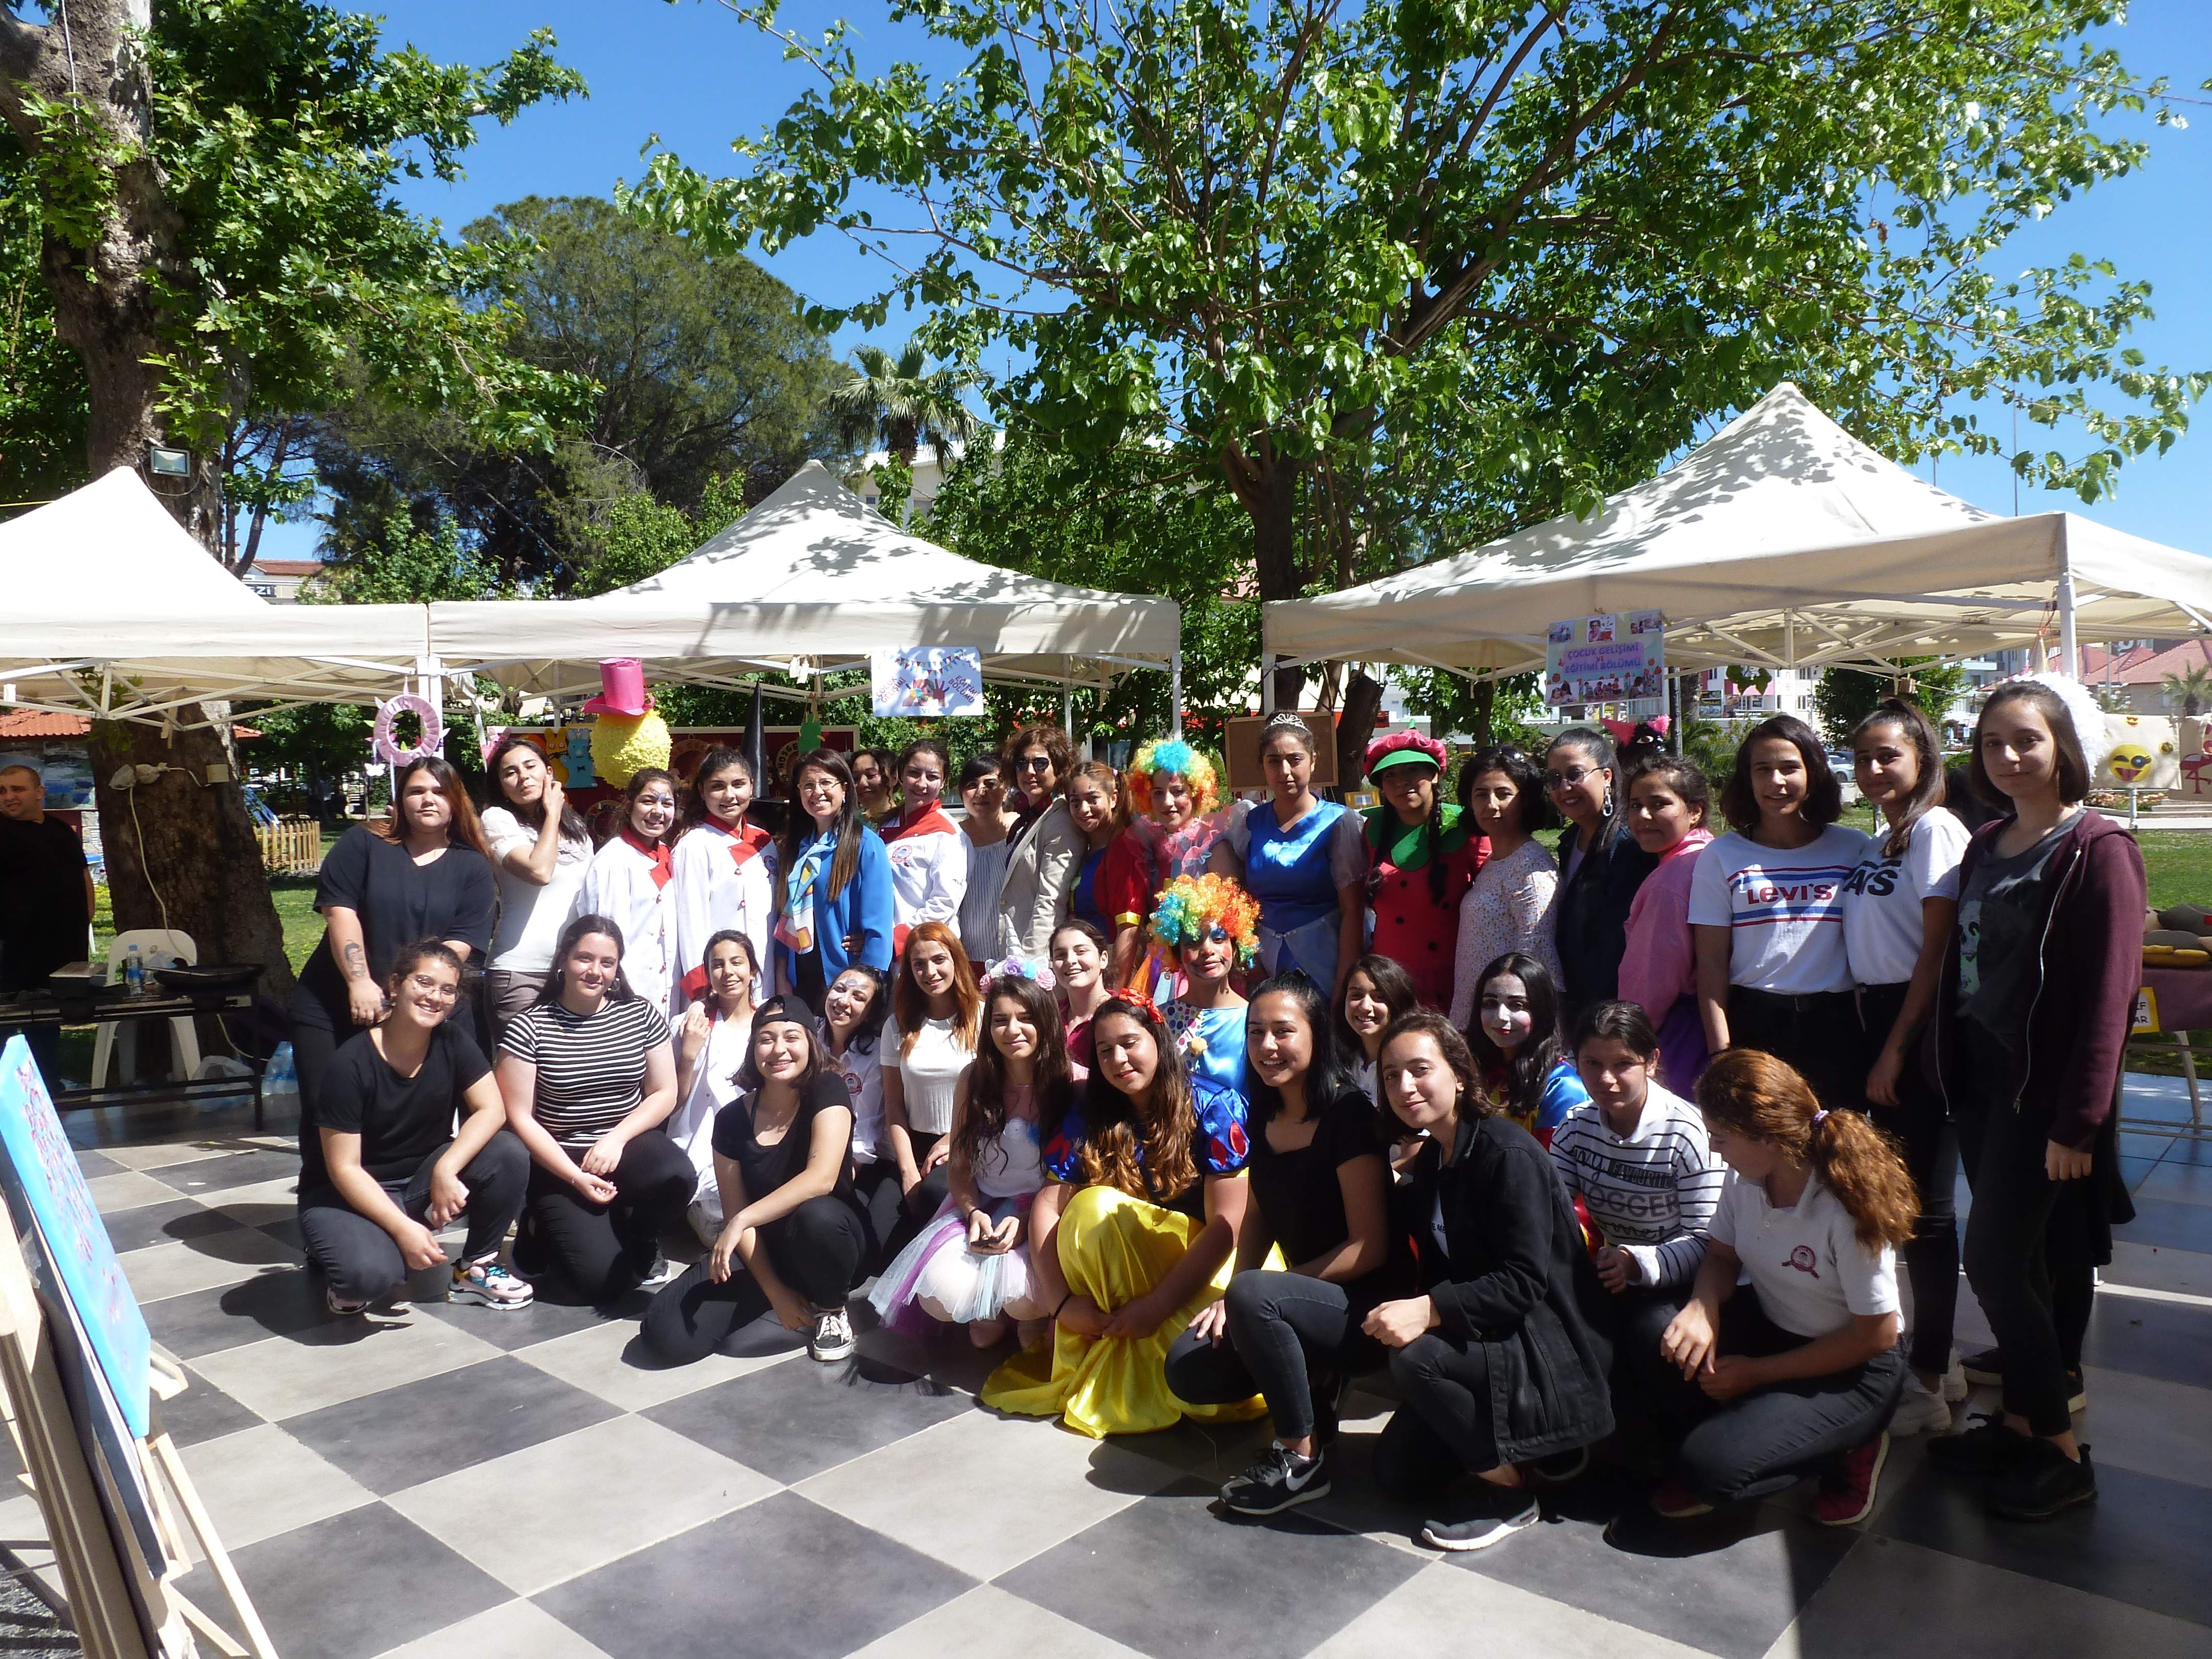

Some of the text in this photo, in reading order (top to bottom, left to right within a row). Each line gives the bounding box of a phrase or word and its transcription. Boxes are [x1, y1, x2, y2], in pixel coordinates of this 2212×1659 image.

[1568, 642, 1639, 660] ÇOCUK GELİŞİMİ
[1565, 657, 1641, 673] EĞİTİMİ BÖLÜMÜ
